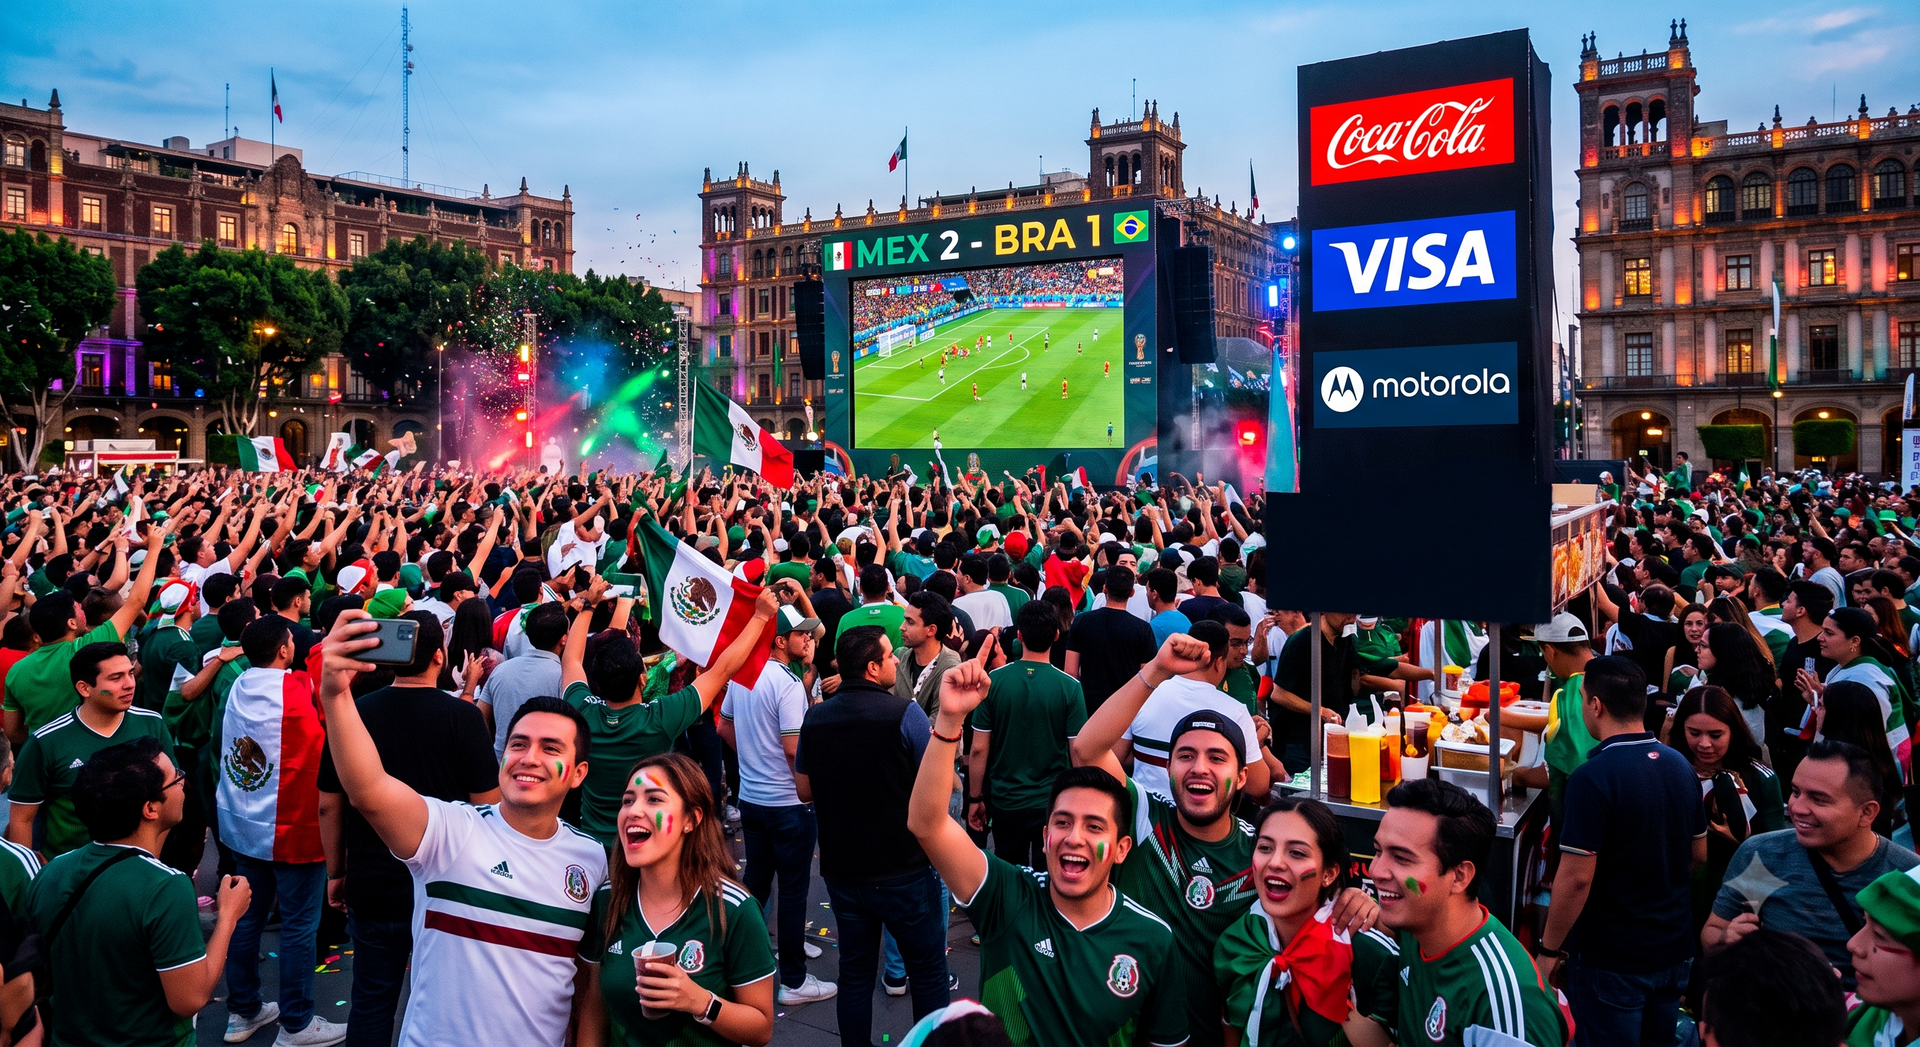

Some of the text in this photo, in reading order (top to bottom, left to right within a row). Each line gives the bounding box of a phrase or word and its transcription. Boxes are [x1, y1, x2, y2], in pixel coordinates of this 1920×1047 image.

[1327, 95, 1495, 169] Coca-Cola
[857, 233, 930, 268] MEX
[940, 230, 960, 261] 2
[995, 218, 1077, 256] BRA
[1087, 215, 1101, 247] 1
[1329, 230, 1495, 294] VISA
[1373, 368, 1510, 399] motorola
